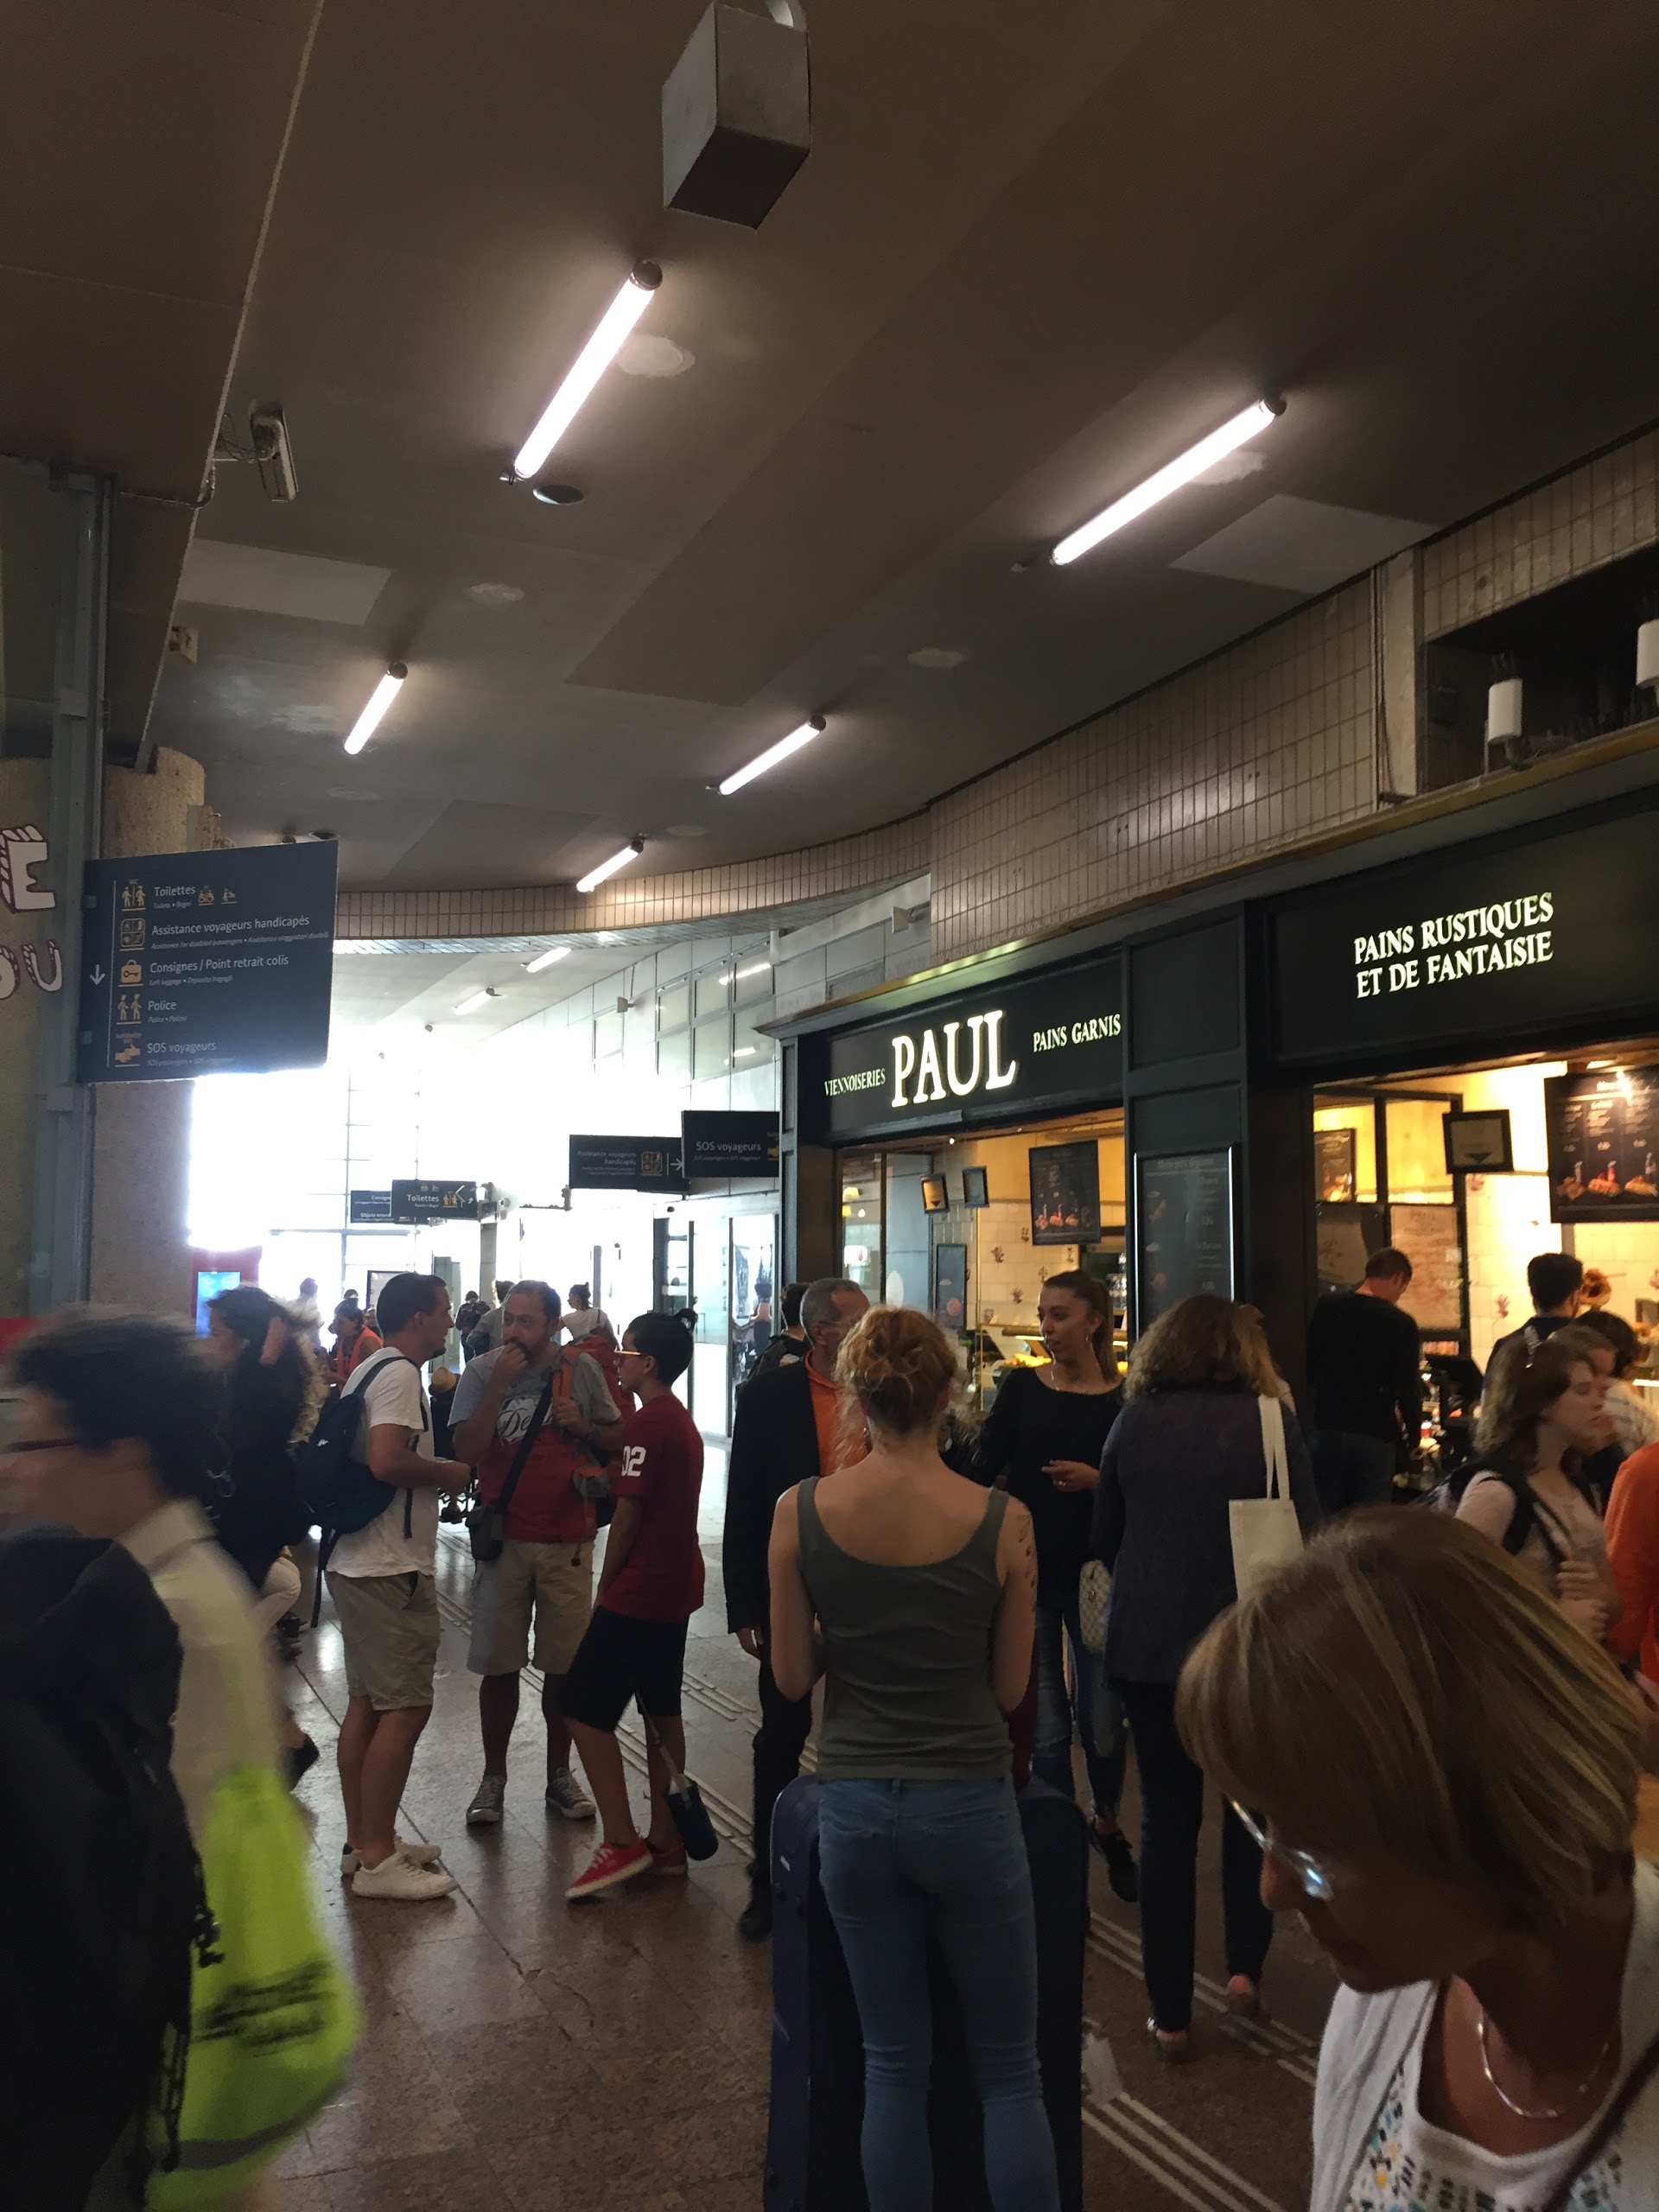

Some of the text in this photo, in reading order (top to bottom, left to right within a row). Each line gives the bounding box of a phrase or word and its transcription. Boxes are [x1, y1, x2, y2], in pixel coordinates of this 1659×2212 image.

[154, 886, 196, 897] Toilettes
[151, 915, 310, 935] Assistance voyageurs handicapés
[1353, 892, 1554, 965] PAINS RUSTIQUES
[149, 961, 198, 974] Consignes
[206, 958, 232, 969] Point
[233, 956, 264, 969] retrait
[266, 954, 289, 966] colis
[1356, 931, 1554, 999] ET DE FANTAISIE
[148, 1000, 176, 1011] Police
[1033, 1014, 1121, 1052] PAINS GARNIS
[147, 1042, 216, 1054] SOS voyageurs
[891, 1009, 1018, 1109] PAUL
[824, 1068, 886, 1096] VIENNOISERIES
[696, 1141, 761, 1154] SOS voyageurs
